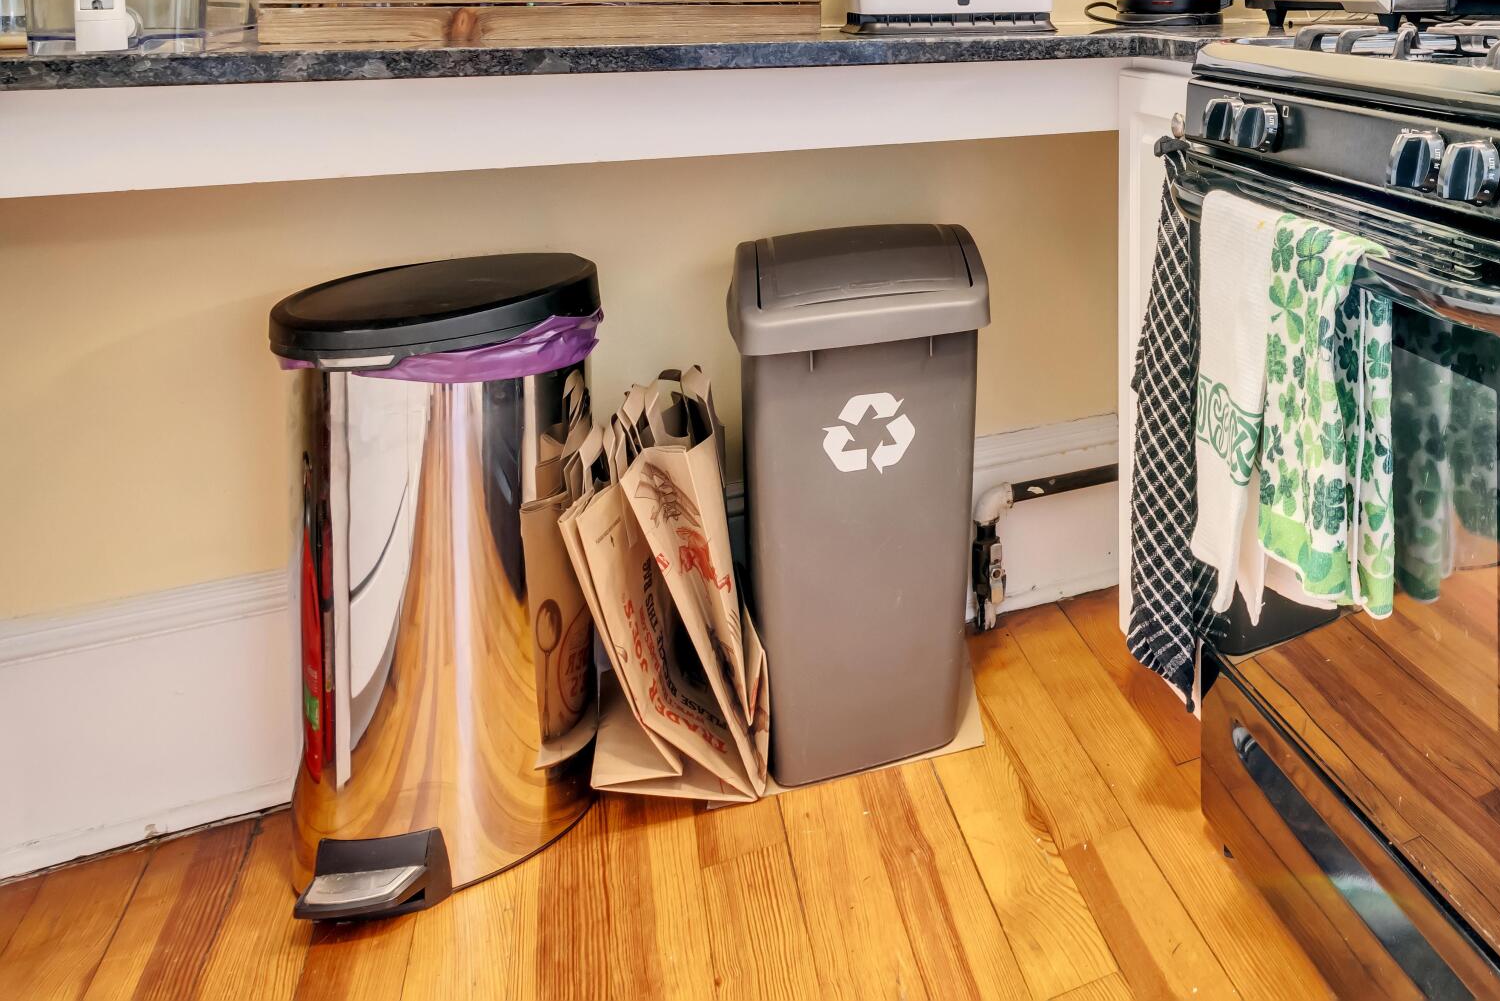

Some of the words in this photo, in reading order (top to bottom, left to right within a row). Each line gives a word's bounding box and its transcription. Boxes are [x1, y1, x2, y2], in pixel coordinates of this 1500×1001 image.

[622, 599, 649, 673] JOE'S
[644, 598, 661, 628] THIS
[648, 679, 728, 754] TRADER
